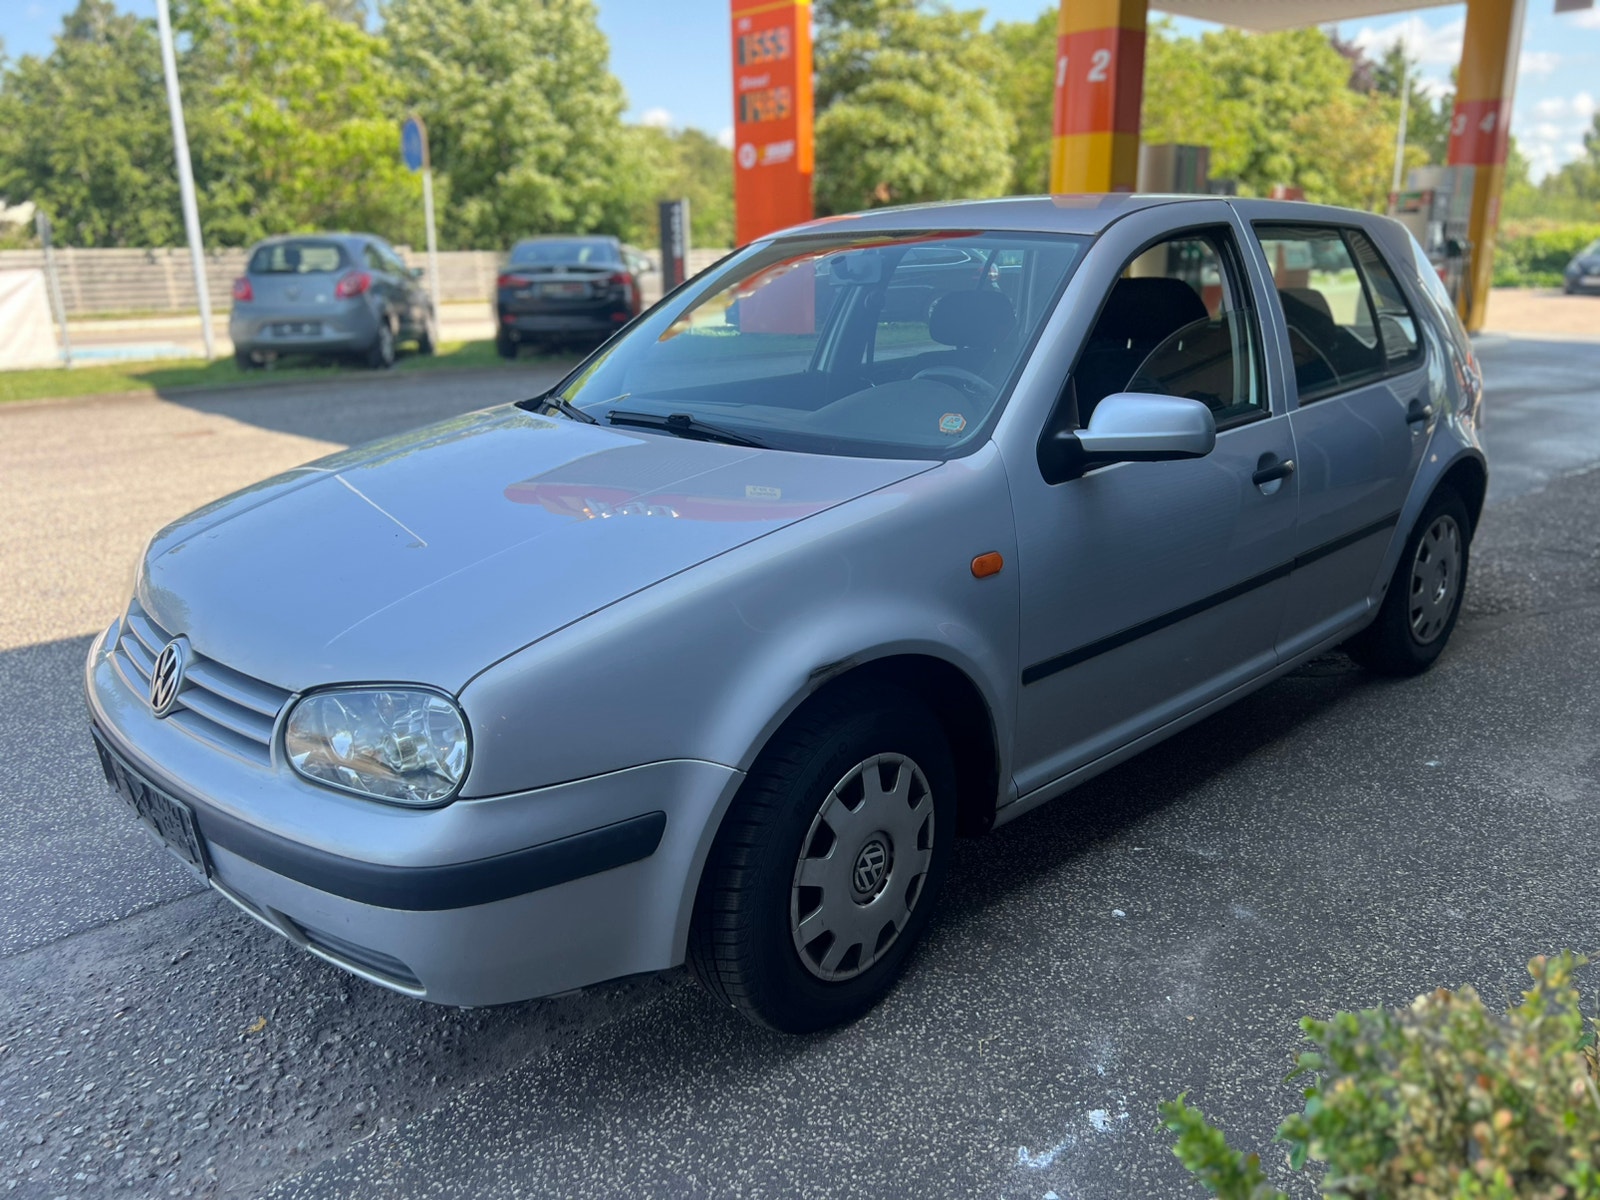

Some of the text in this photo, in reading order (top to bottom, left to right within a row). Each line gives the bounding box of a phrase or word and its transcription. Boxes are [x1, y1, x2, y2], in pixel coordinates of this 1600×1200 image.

[1057, 48, 1111, 87] 1 2
[1453, 110, 1495, 136] 3 4
[151, 643, 181, 713] VW
